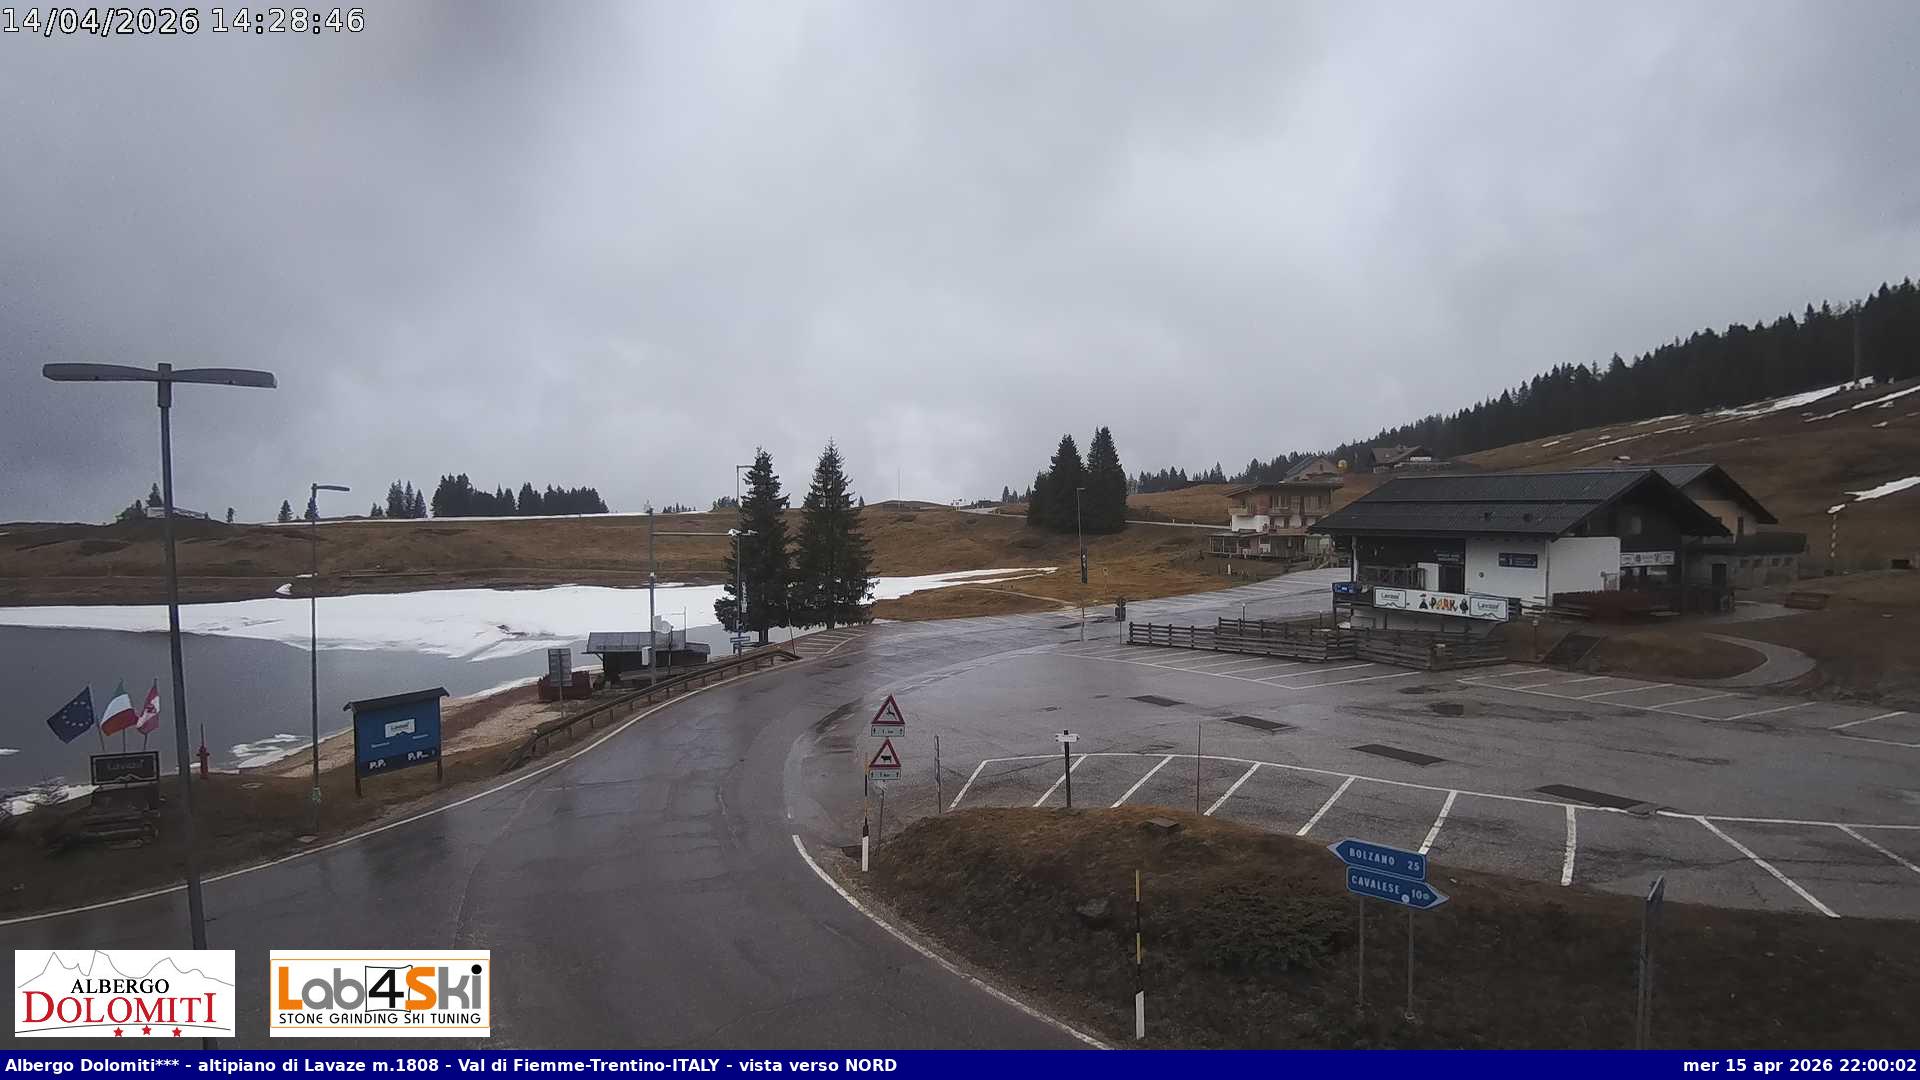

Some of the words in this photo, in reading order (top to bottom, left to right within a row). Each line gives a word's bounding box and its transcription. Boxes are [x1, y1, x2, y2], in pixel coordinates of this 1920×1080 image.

[1348, 847, 1396, 866] BOLZANO
[1407, 860, 1420, 871] 25
[1351, 875, 1401, 895] CAVALESE
[1411, 889, 1423, 900] 10
